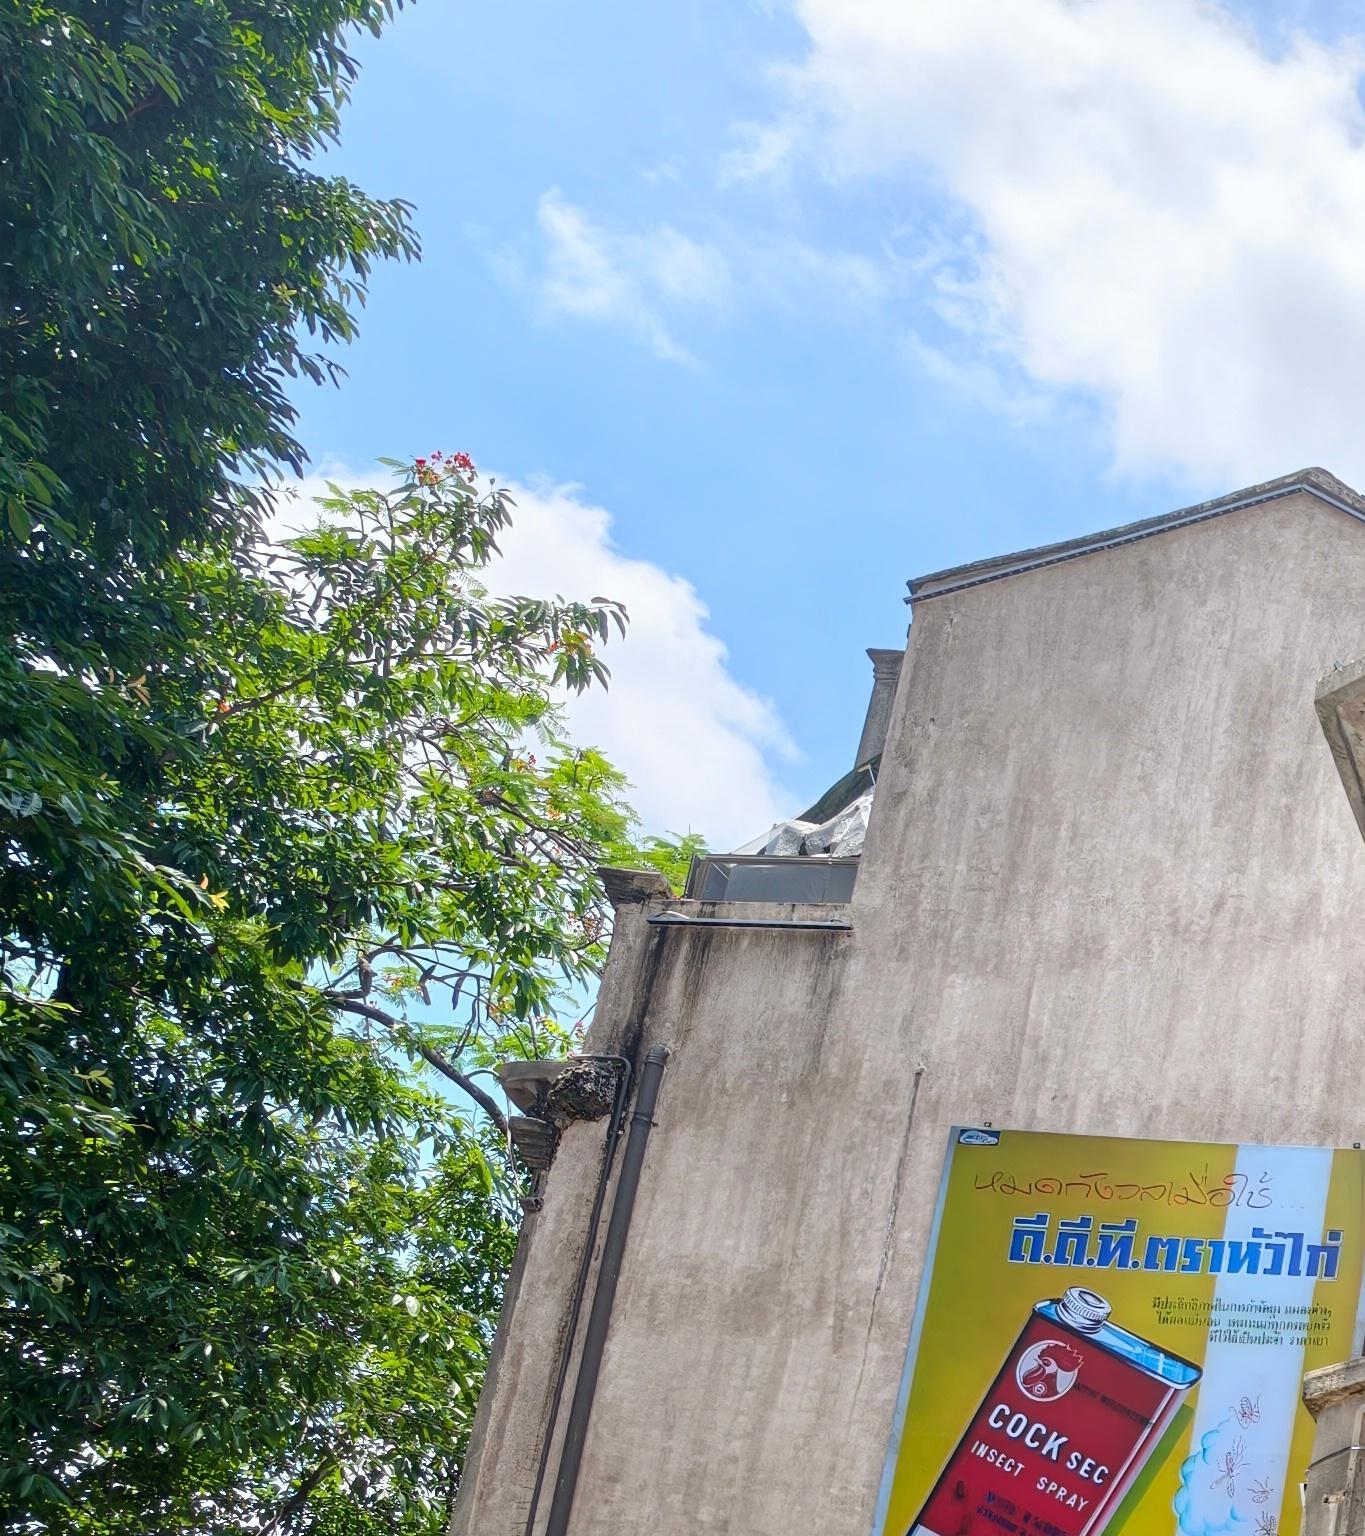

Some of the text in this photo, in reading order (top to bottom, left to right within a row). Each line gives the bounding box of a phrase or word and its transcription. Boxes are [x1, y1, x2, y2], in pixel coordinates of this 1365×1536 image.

[970, 1440, 1090, 1512] INSECT SPRAY
[988, 1404, 1069, 1461] COCK
[1066, 1452, 1109, 1484] SEC
